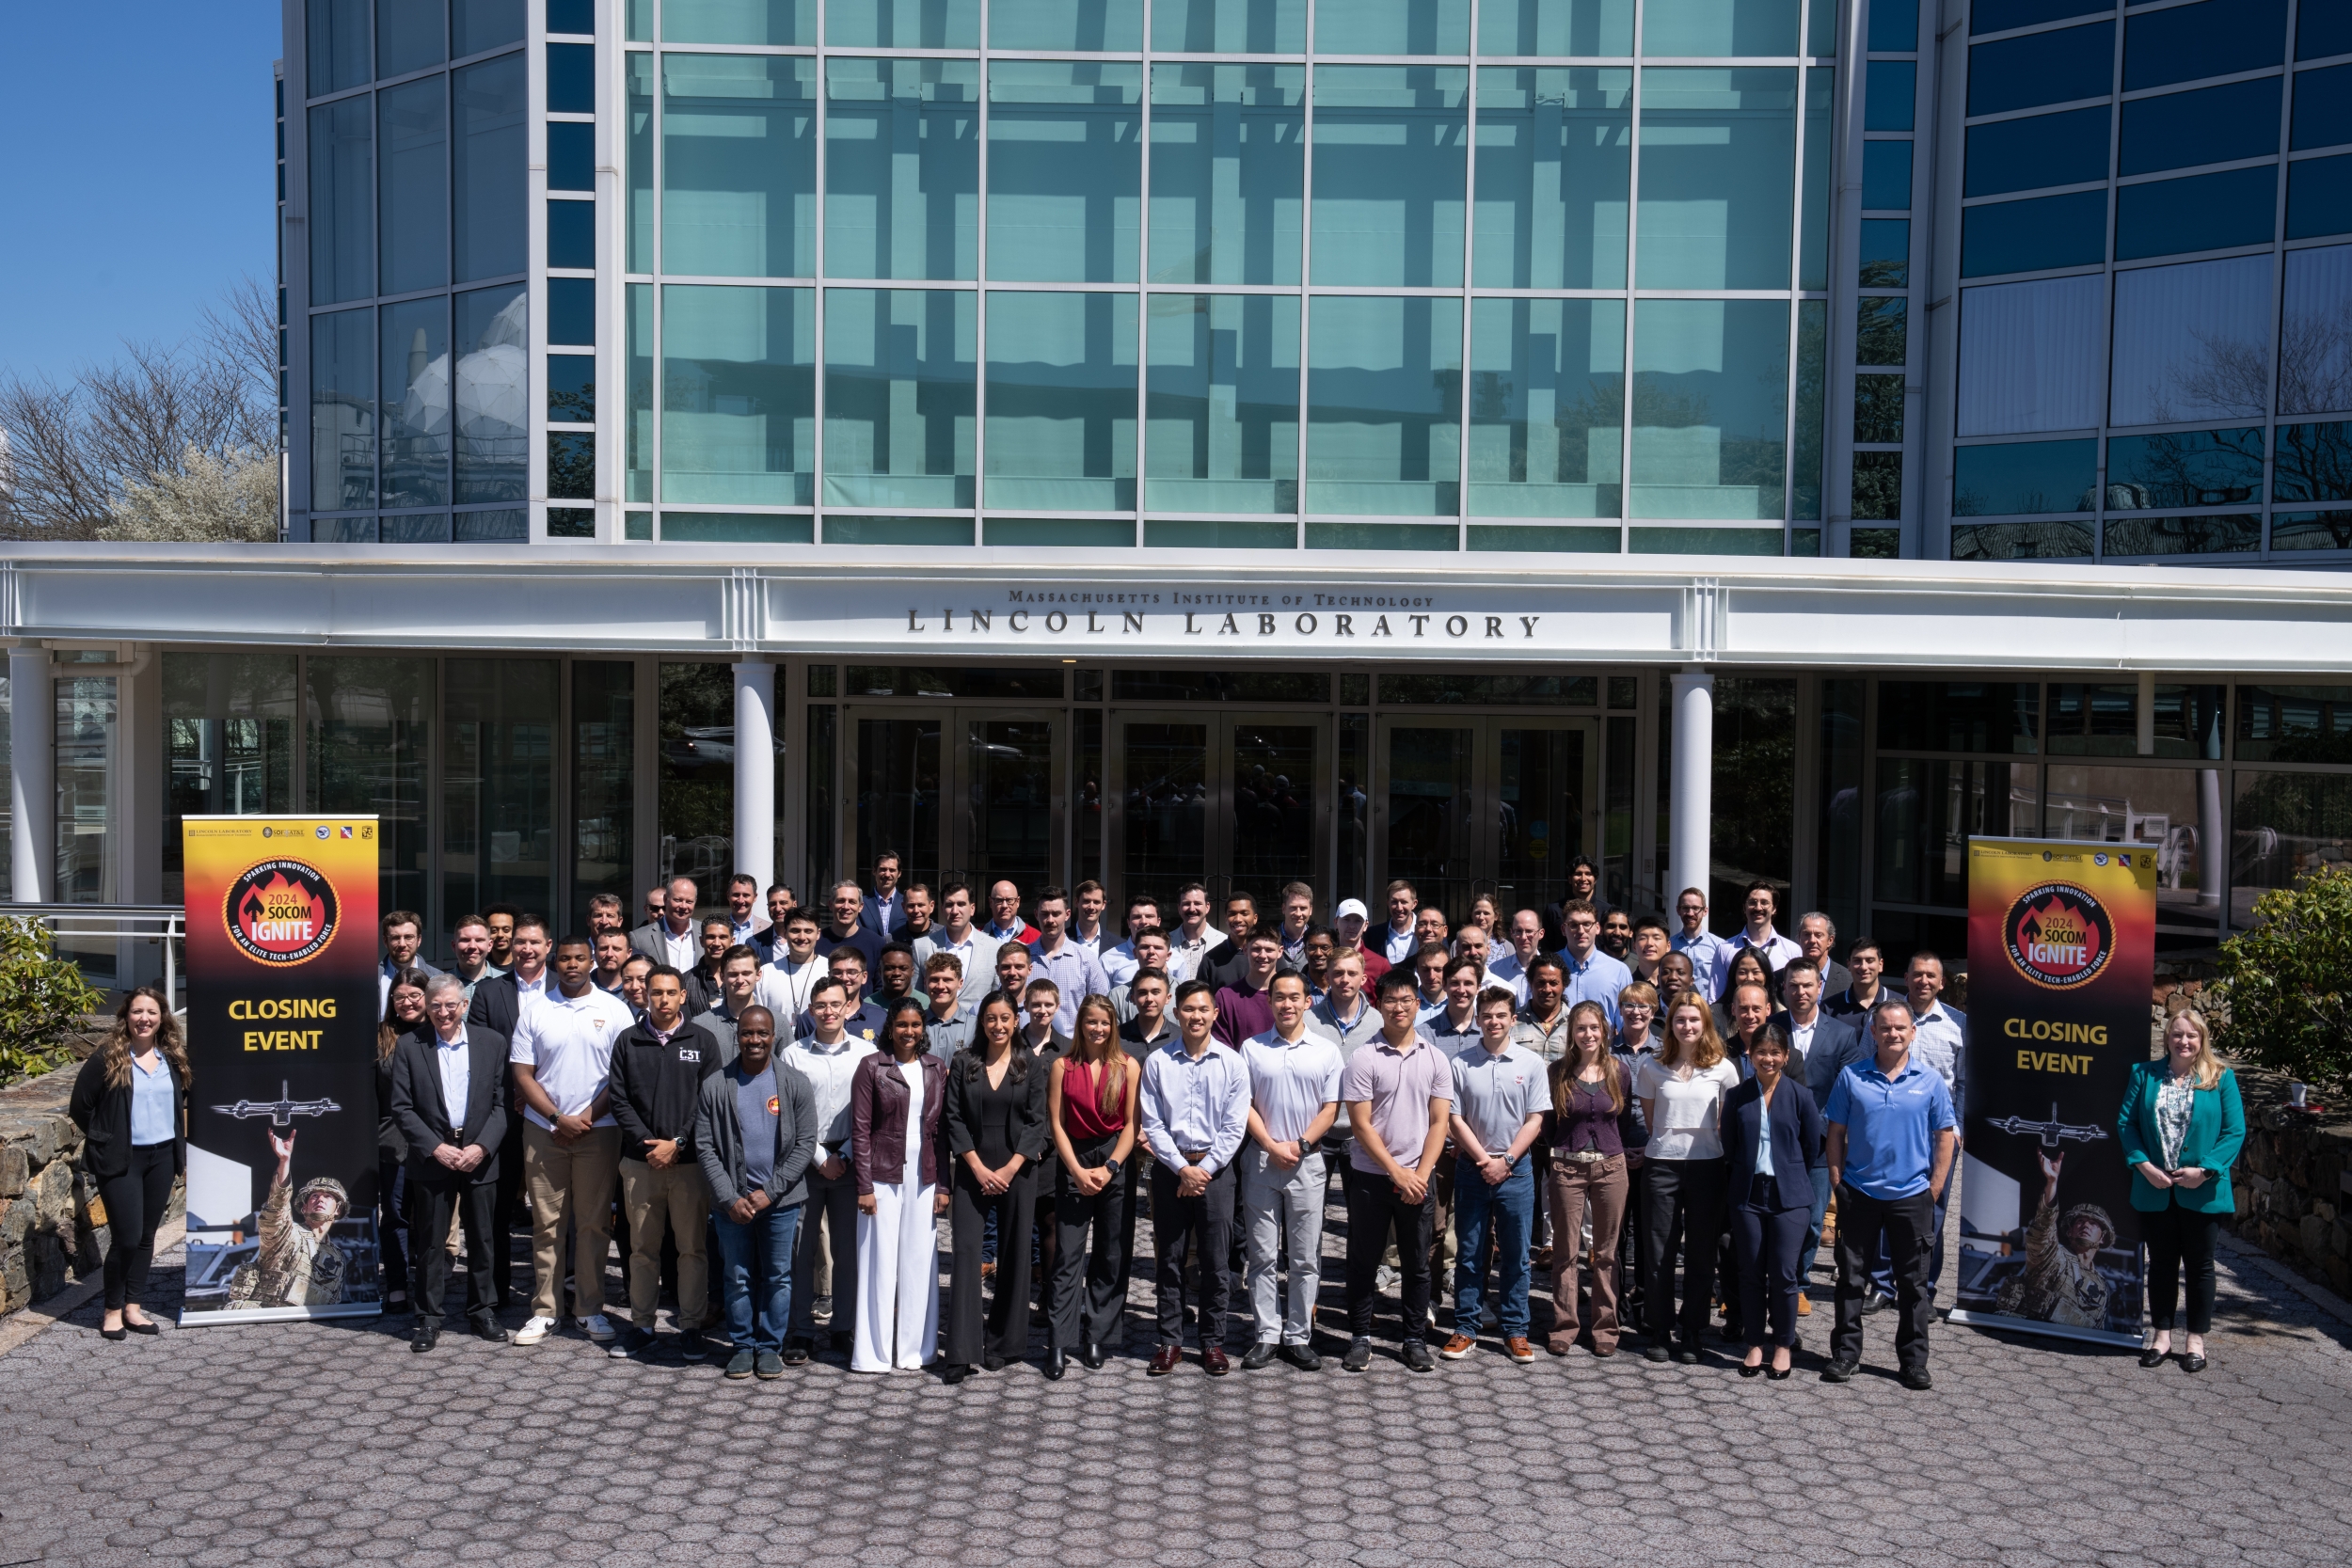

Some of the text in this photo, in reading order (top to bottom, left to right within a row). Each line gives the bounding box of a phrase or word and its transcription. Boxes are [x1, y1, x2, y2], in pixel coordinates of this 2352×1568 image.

[1009, 590, 1435, 607] MASSACHUSETTS INSTITUTE OF TECHNOLOGY
[907, 609, 1540, 638] LINCOLN LABORATORY
[243, 862, 321, 882] SPARKING INNOVATION
[268, 894, 297, 905] 2024
[2022, 885, 2097, 908] SPARKING INNOVATION
[268, 906, 312, 919] SOCOM
[2044, 917, 2074, 929] 2024
[231, 923, 333, 960] FOR AN ELITE TECH-ENABLED FORCE
[251, 921, 313, 942] IGNITE
[2044, 929, 2087, 944] SOCOM
[2010, 944, 2106, 984] FOR AN ELITE TECH-ENABLED FORCE
[2028, 942, 2087, 966] IGNITE
[229, 998, 337, 1020] CLOSING
[244, 1030, 324, 1051] EVENT
[2004, 1018, 2107, 1045] CLOSING
[2017, 1050, 2094, 1075] EVENT
